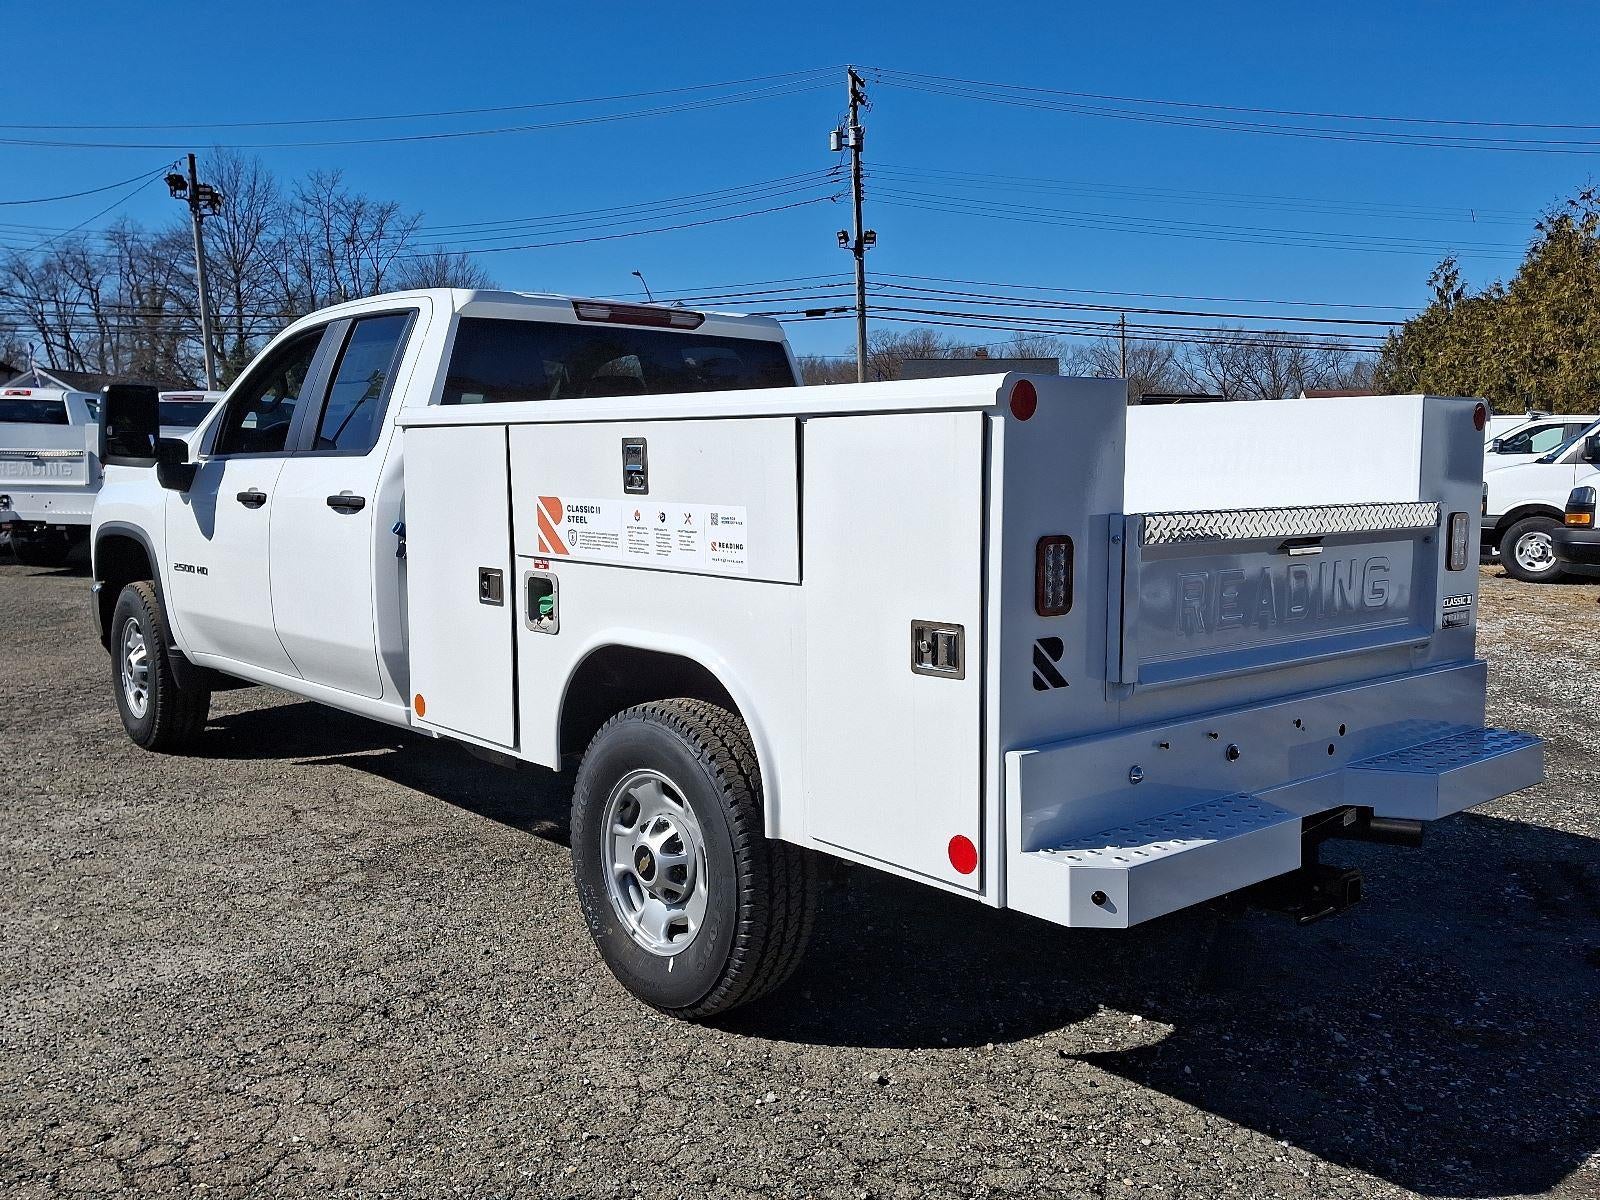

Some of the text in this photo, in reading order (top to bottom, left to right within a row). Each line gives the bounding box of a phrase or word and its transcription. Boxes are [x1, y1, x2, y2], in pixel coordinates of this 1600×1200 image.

[566, 504, 595, 514] CLASSIC
[567, 515, 588, 524] STEEL
[173, 562, 209, 576] 2500 HD
[1175, 555, 1391, 637] READING
